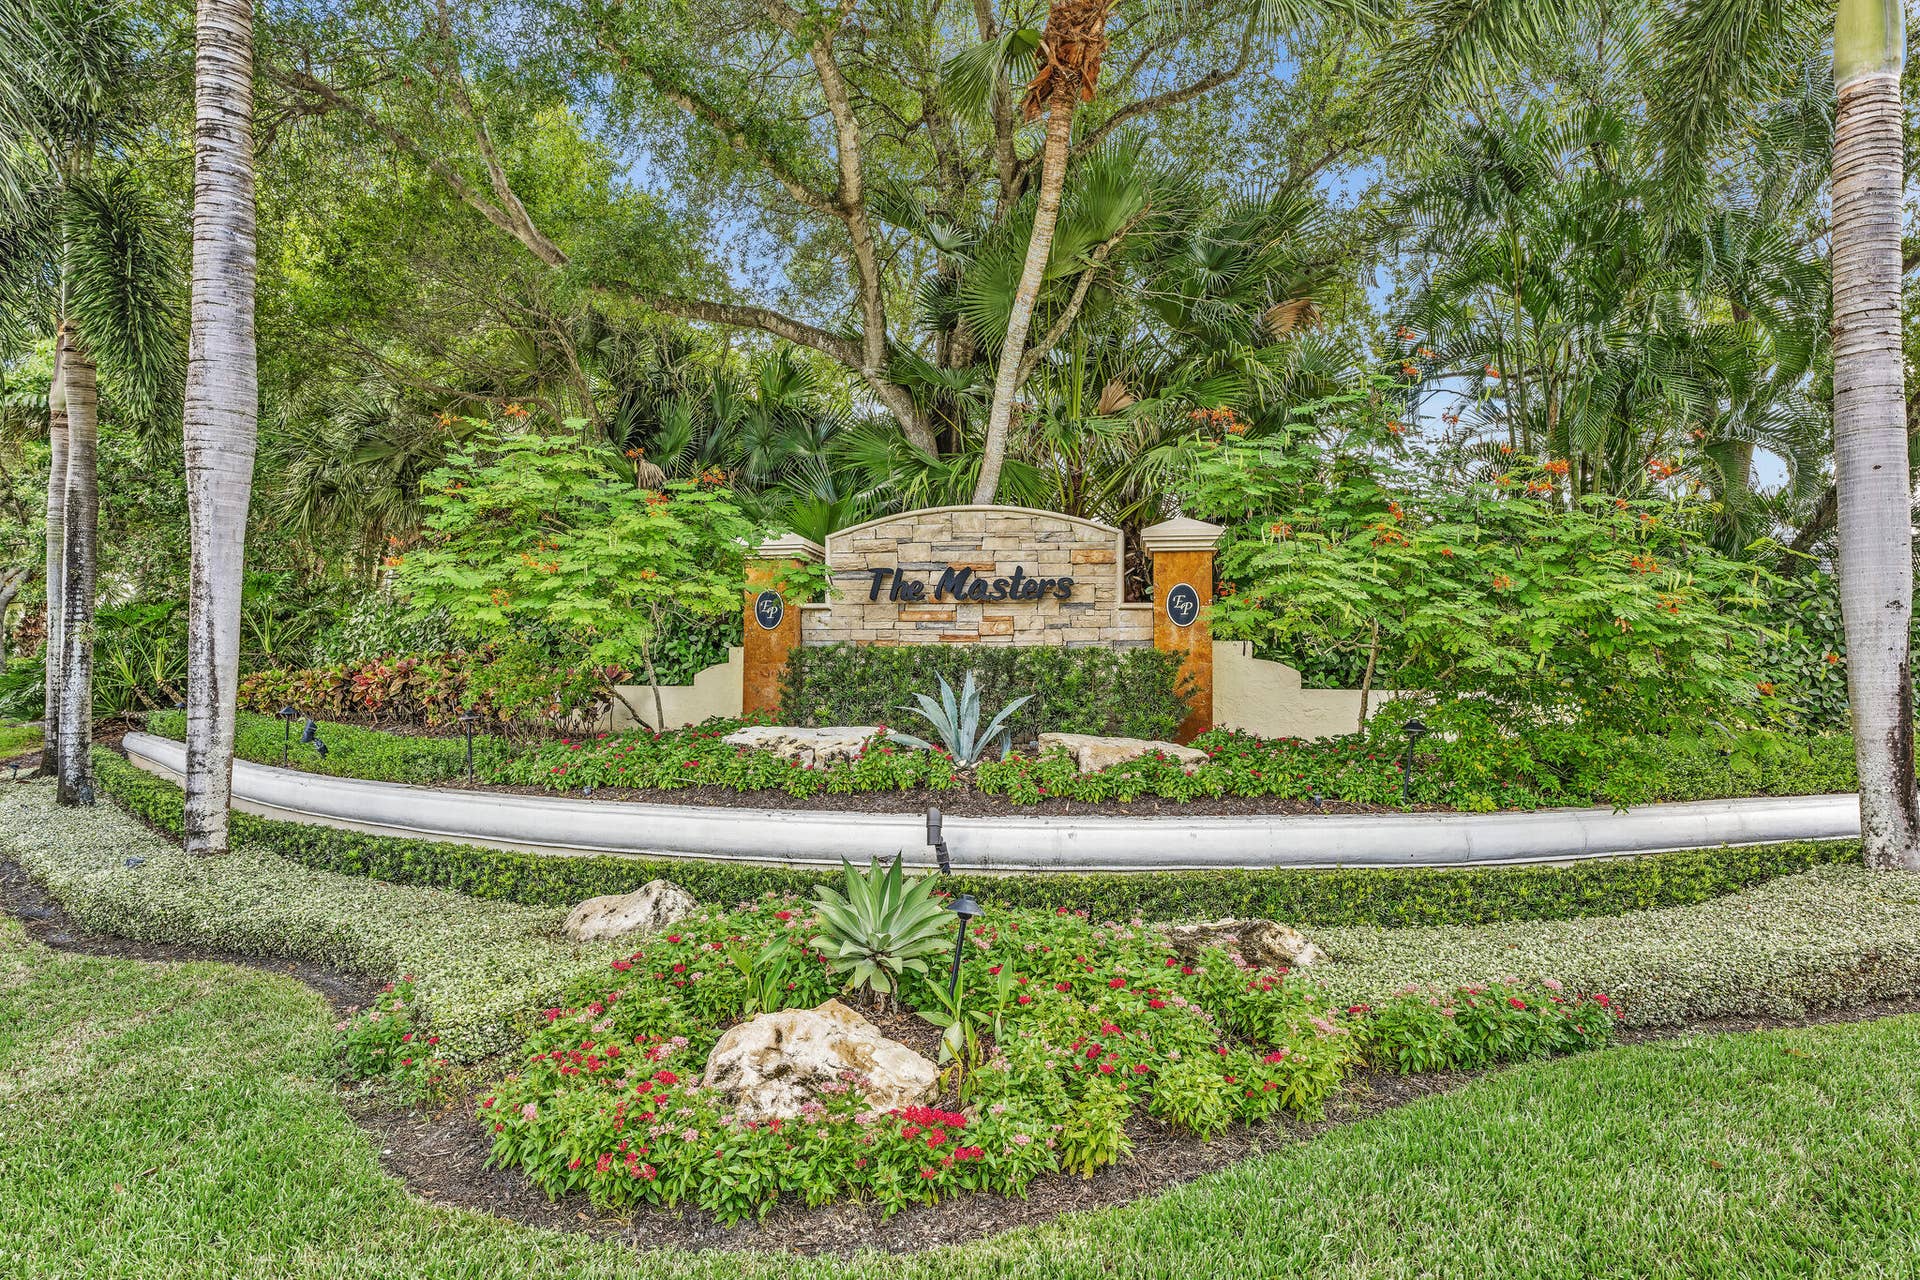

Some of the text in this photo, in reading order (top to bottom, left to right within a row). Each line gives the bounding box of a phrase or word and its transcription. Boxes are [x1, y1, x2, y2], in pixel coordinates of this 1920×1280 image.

[868, 565, 1075, 602] The Masters
[1172, 594, 1194, 616] EP
